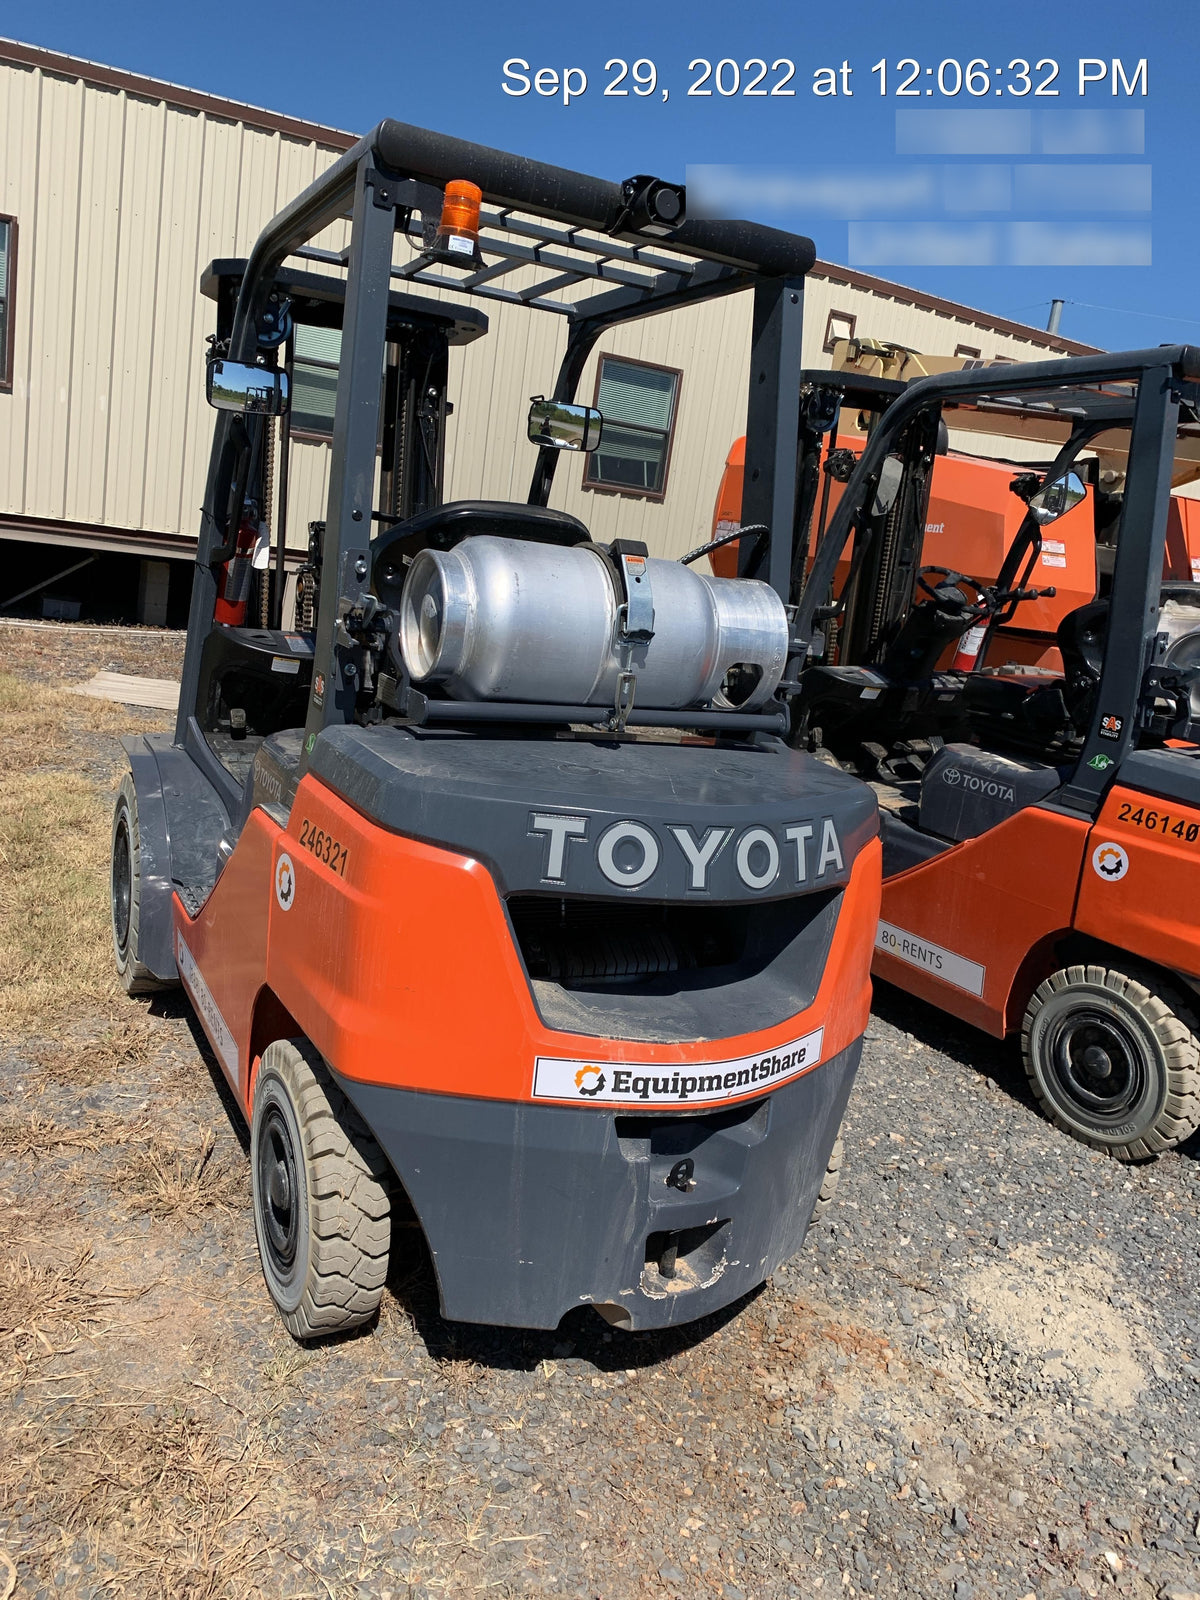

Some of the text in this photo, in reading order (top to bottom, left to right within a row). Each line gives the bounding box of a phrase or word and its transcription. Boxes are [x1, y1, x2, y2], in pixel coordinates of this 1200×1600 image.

[925, 522, 945, 534] ent
[1101, 716, 1122, 732] SAS
[260, 767, 282, 801] TOYOTA
[963, 774, 1014, 802] TOYOTA
[298, 819, 348, 877] 246321
[532, 815, 845, 889] TOYOTA
[881, 930, 943, 970] 80-RENTS
[611, 1047, 806, 1099] EquipmentShare
